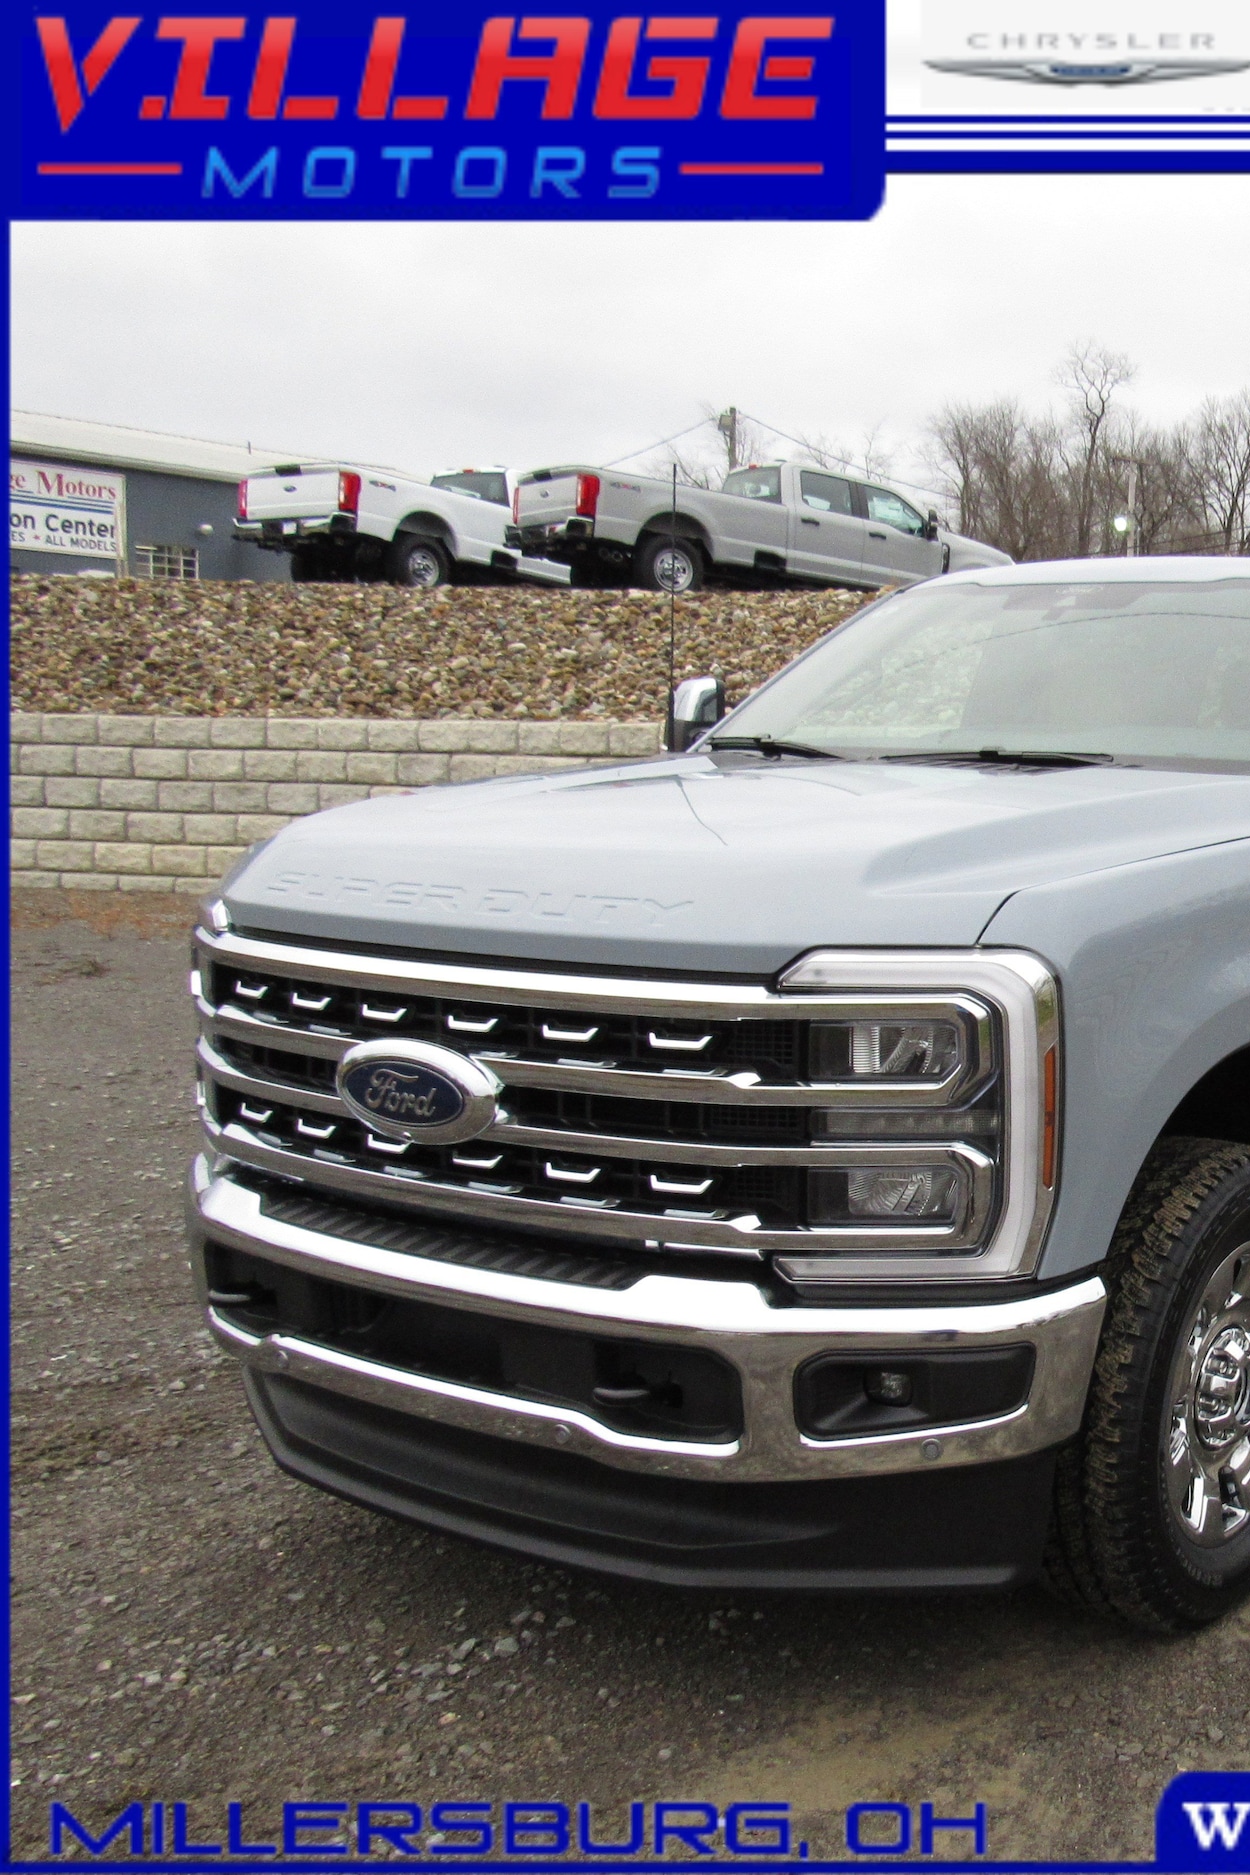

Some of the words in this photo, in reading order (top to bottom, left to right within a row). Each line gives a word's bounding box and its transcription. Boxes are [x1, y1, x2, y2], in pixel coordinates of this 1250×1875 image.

[37, 471, 117, 500] Motors
[45, 514, 116, 539] Center
[45, 535, 66, 547] ALL
[70, 537, 117, 552] MODELS
[265, 871, 470, 914] SUPER
[474, 888, 695, 927] DUTY
[365, 1068, 437, 1117] Ford
